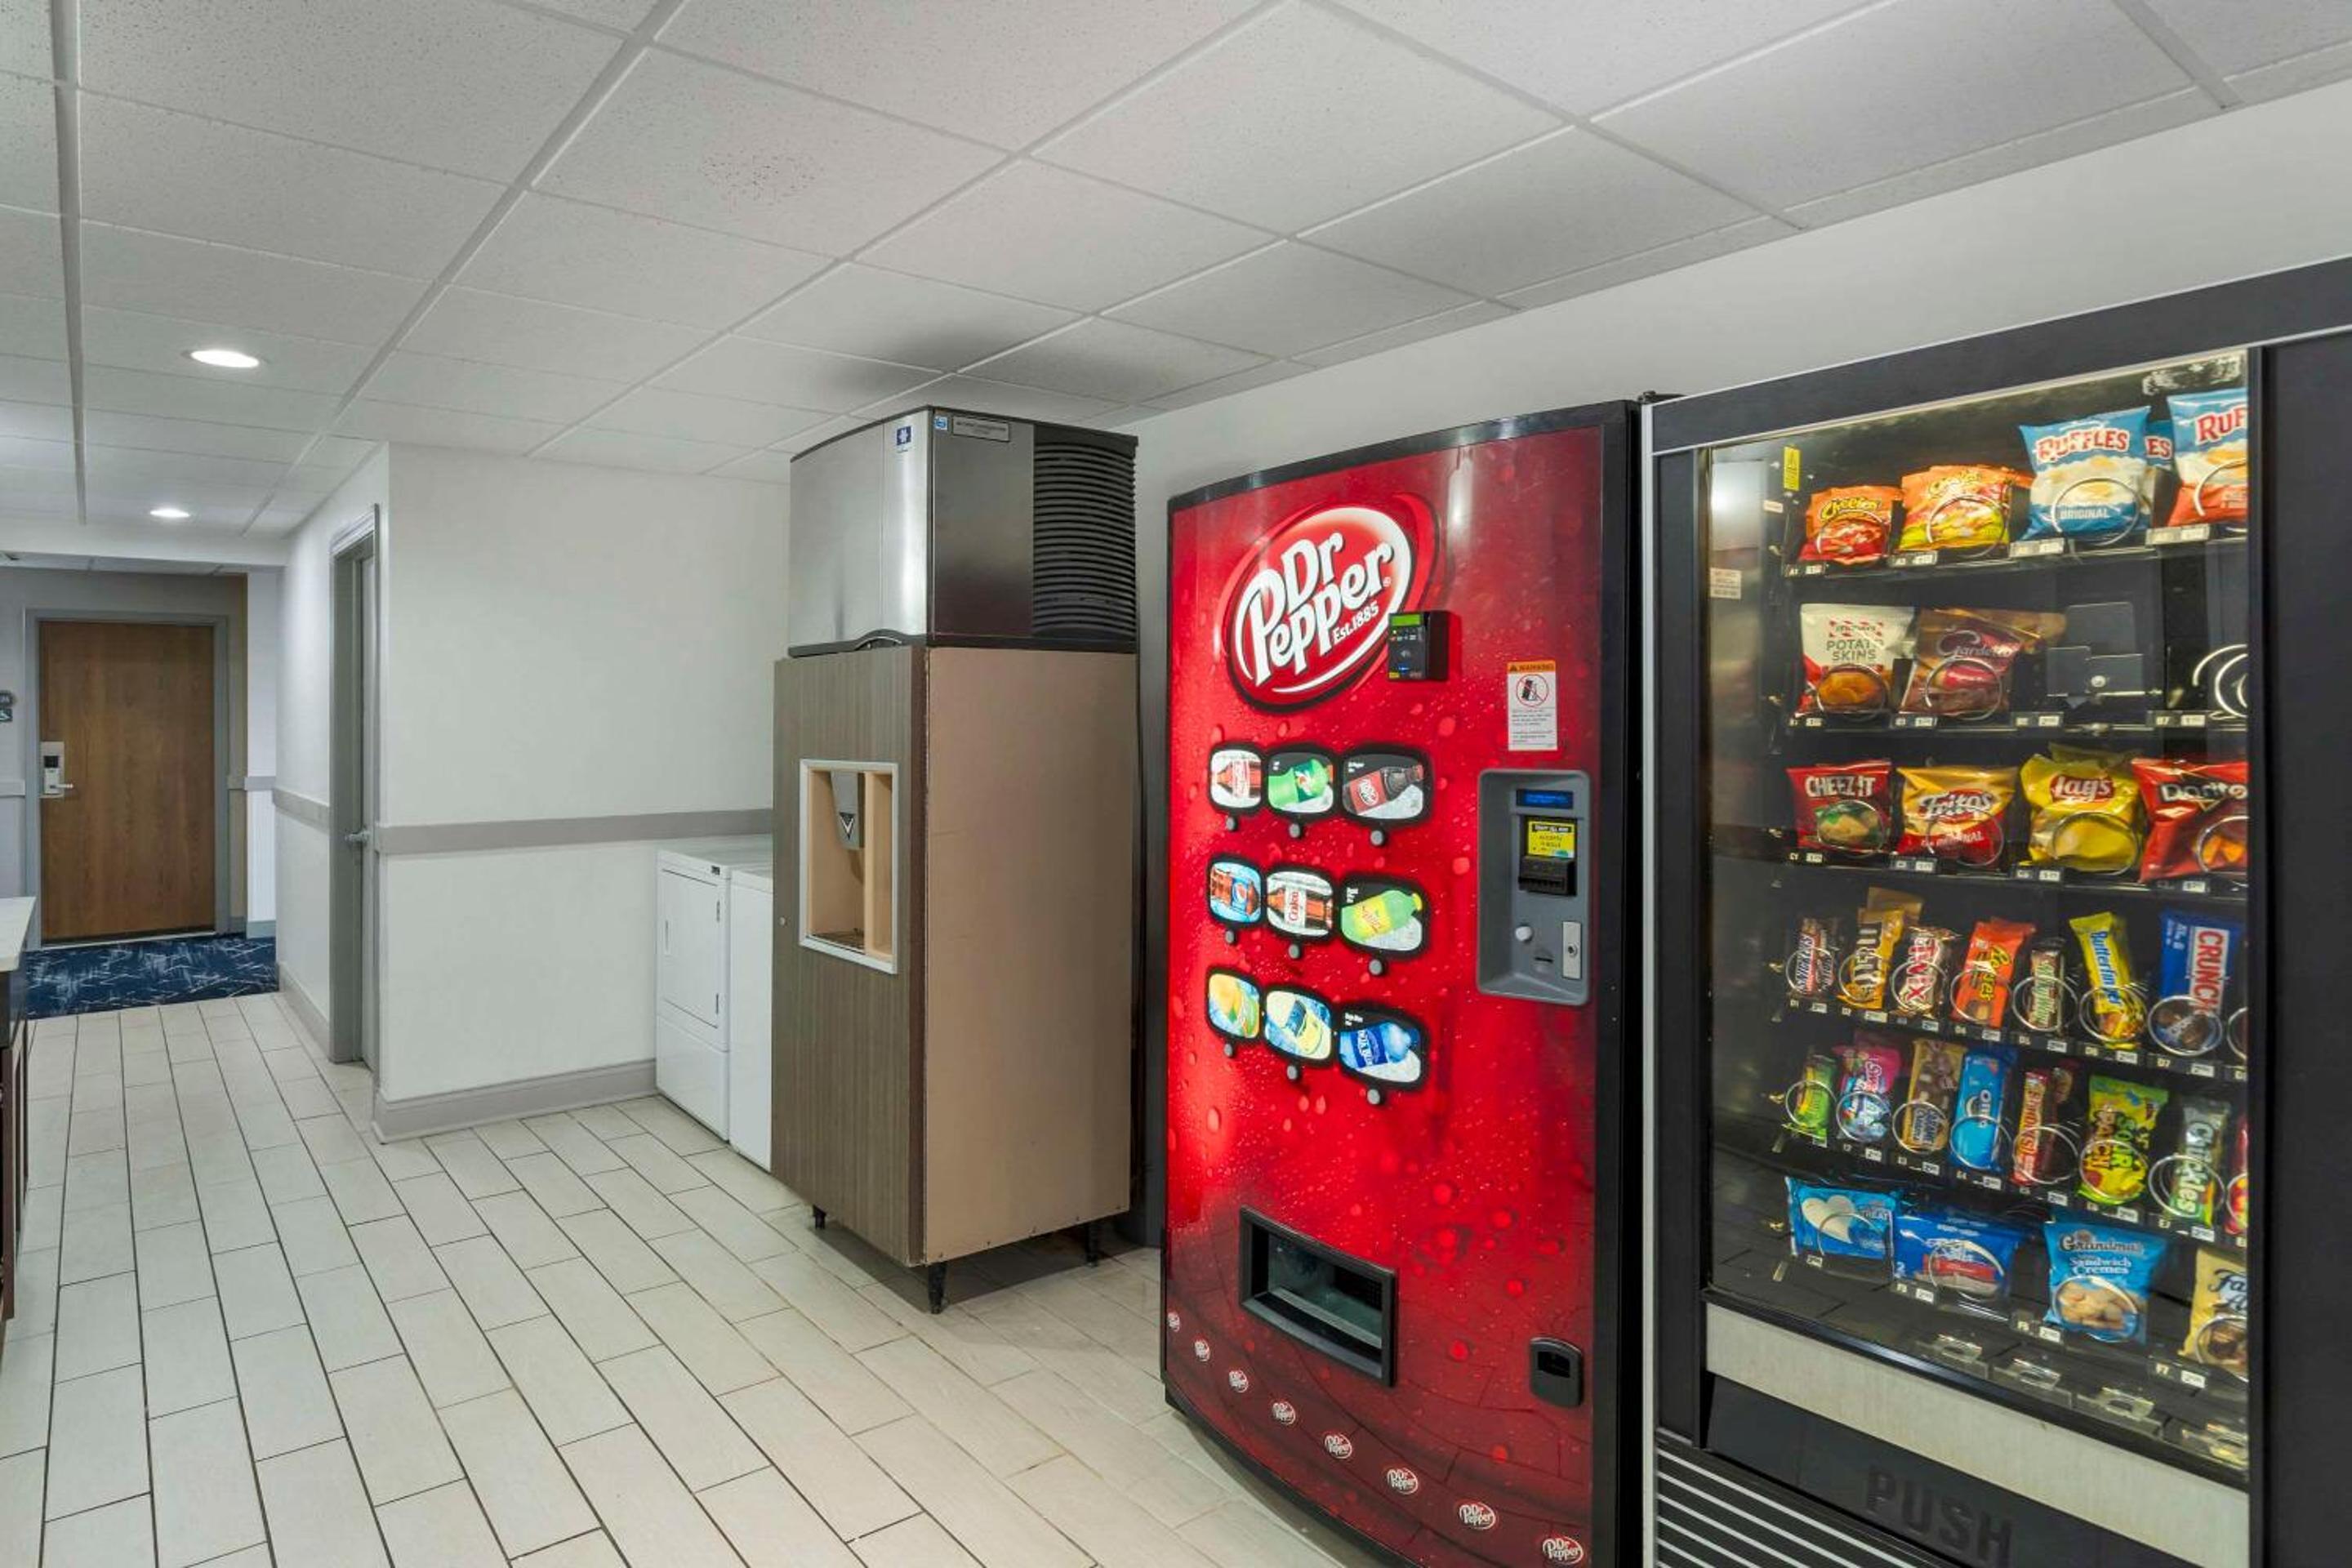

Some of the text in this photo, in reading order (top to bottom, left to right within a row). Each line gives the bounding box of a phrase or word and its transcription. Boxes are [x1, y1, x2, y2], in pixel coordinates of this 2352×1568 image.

[2037, 430, 2130, 462] RUFFLES
[1281, 532, 1343, 612] Dr
[1236, 542, 1395, 686] Pepper
[1832, 649, 1877, 662] SKINS
[1459, 1505, 1492, 1526] Pepper
[1865, 1468, 2014, 1568] PUSH
[1543, 1539, 1579, 1561] Pepper
